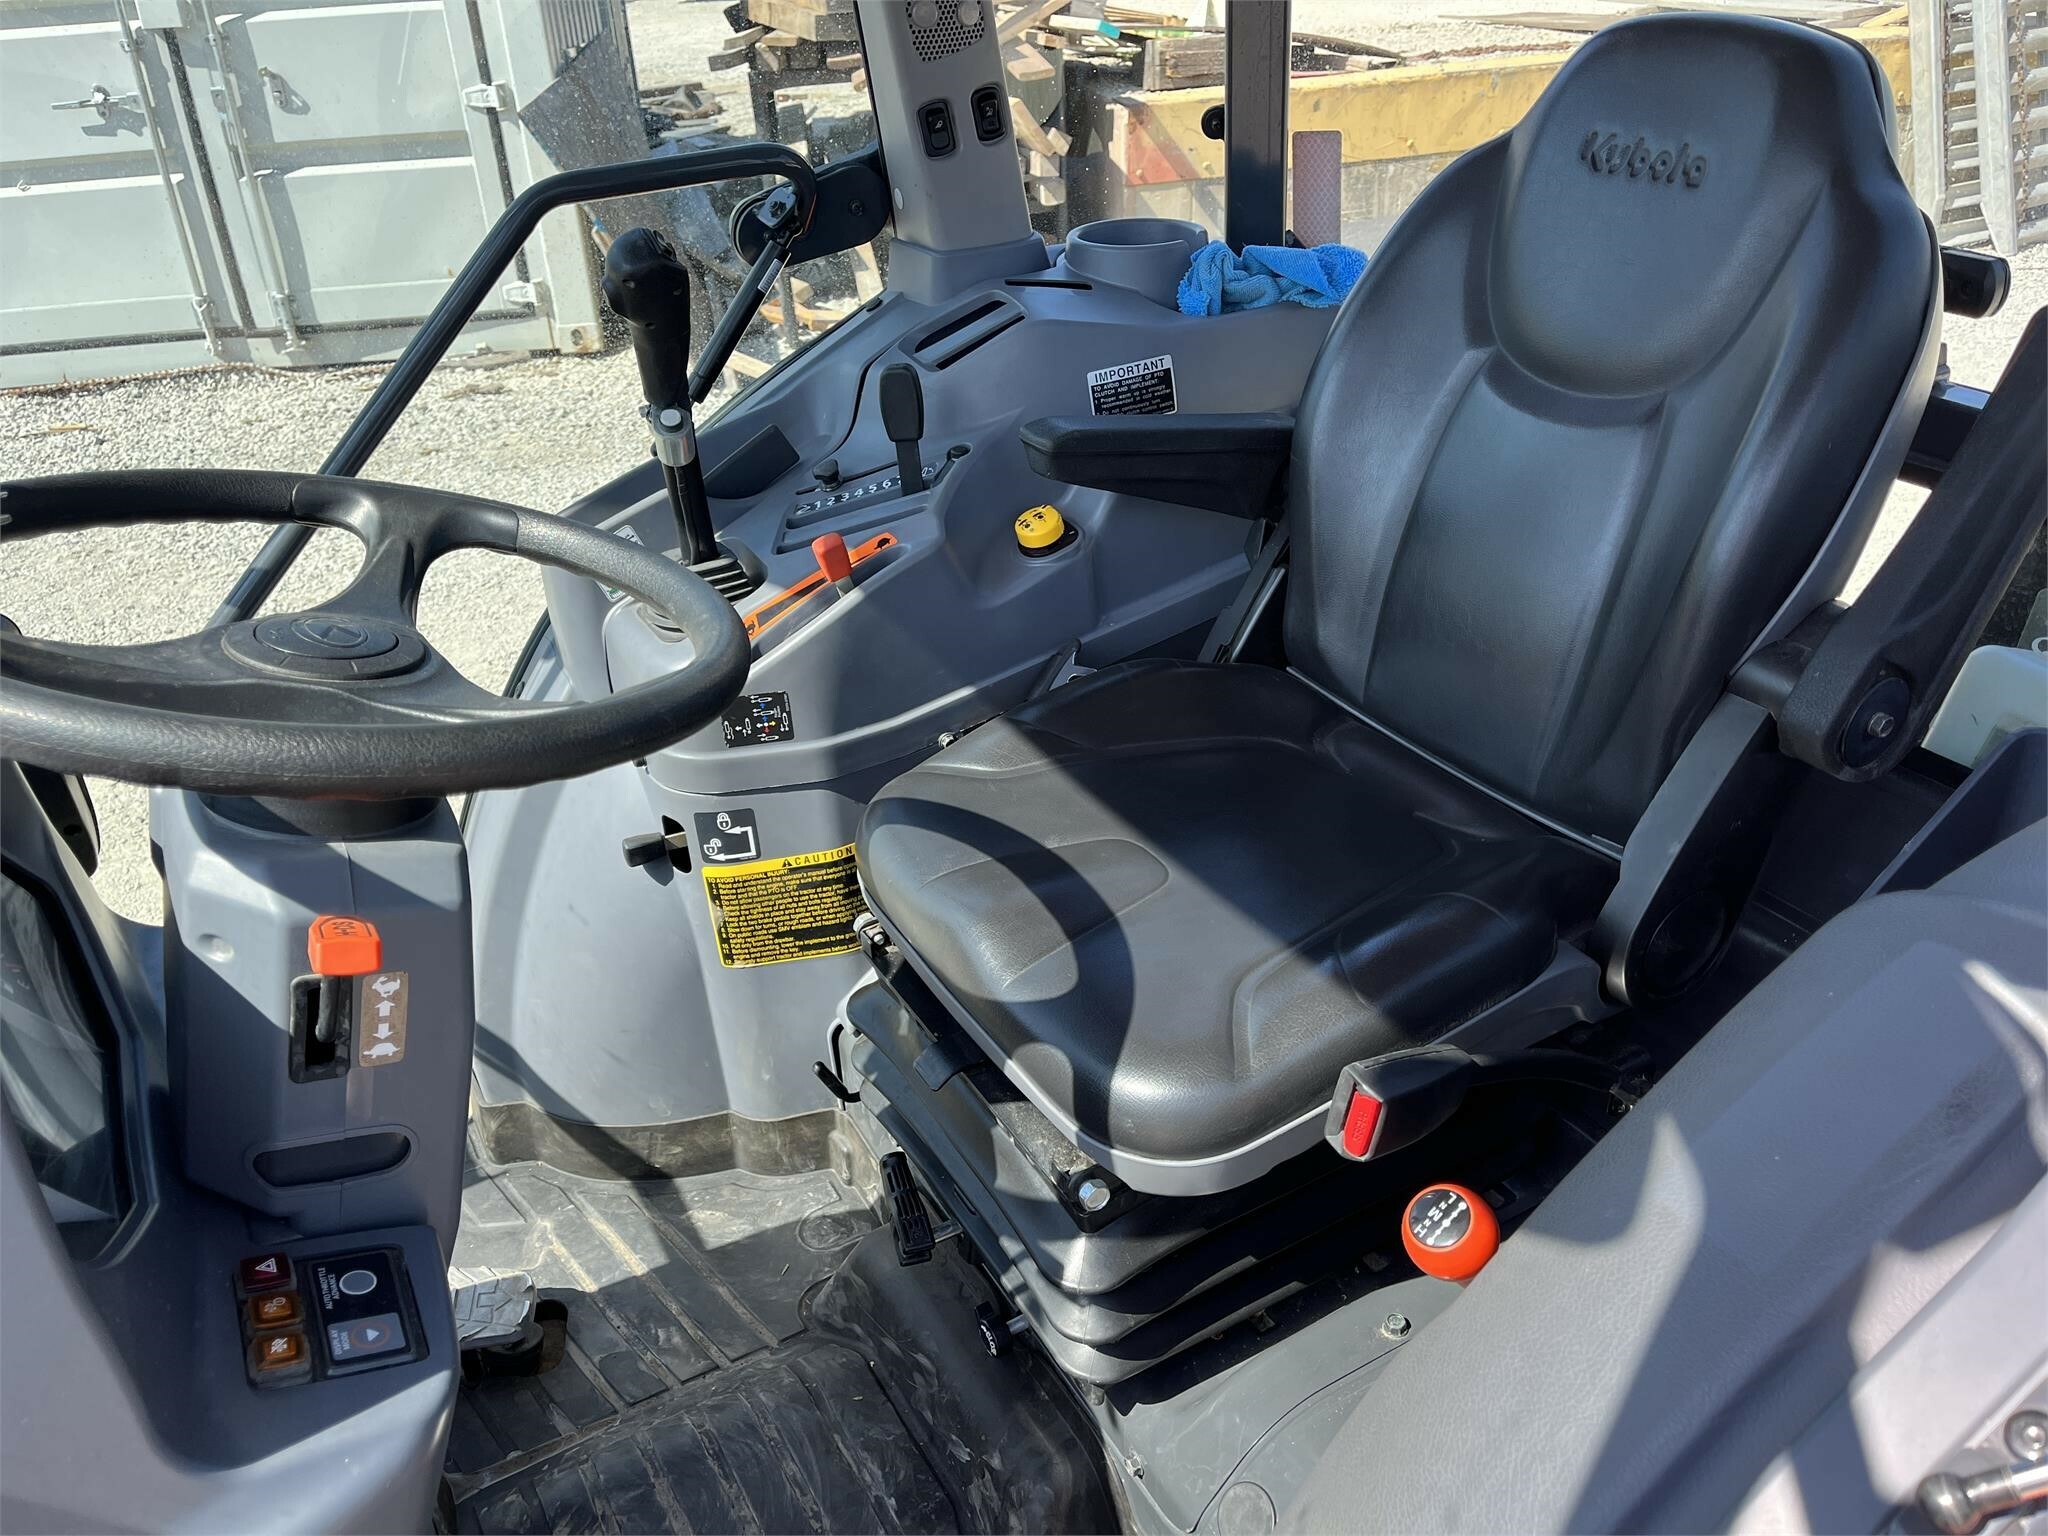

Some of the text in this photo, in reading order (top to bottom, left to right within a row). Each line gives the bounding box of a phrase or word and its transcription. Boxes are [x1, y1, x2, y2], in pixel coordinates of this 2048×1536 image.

[1579, 131, 1708, 188] Kubota
[1094, 357, 1165, 383] IMPORTANT
[1094, 390, 1115, 398] CLUTCH
[1103, 382, 1119, 390] AVOID
[795, 846, 852, 866] CAUTION
[1414, 1224, 1427, 1237] H
[1428, 1206, 1443, 1221] M
[1448, 1192, 1457, 1204] L
